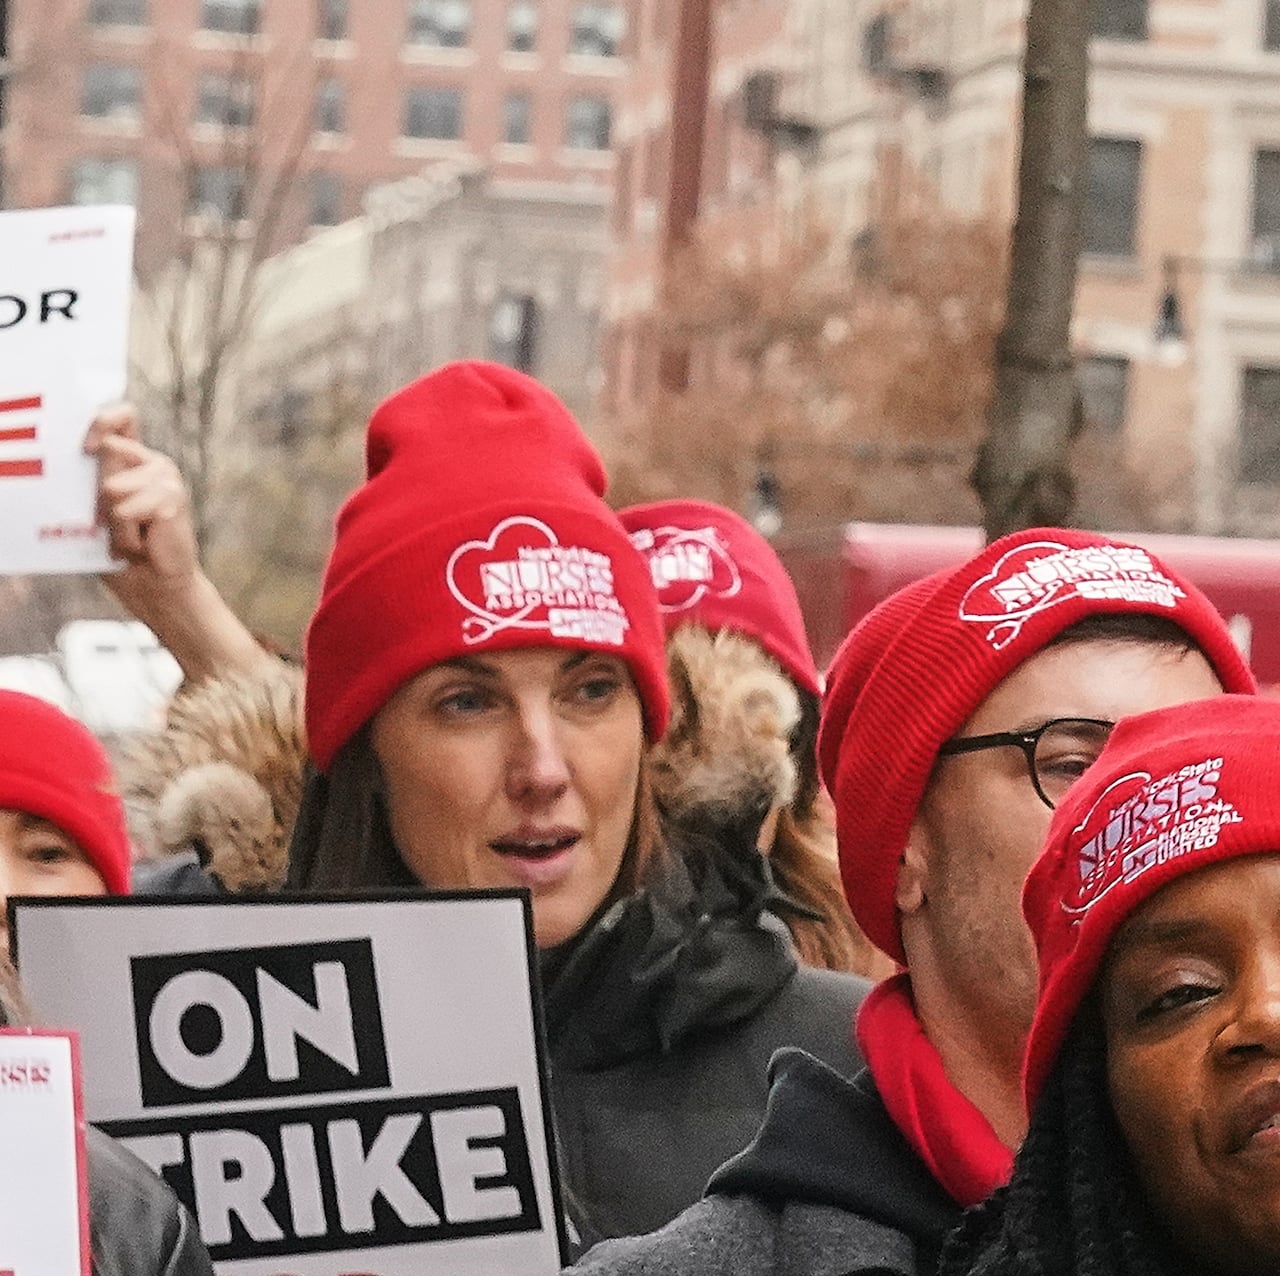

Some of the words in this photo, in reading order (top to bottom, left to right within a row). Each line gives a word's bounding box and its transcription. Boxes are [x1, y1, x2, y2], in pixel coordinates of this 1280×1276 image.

[480, 560, 614, 597] NURSES
[989, 552, 1154, 605] NURSES
[1079, 771, 1221, 882] NURSES
[149, 961, 359, 1091] ON
